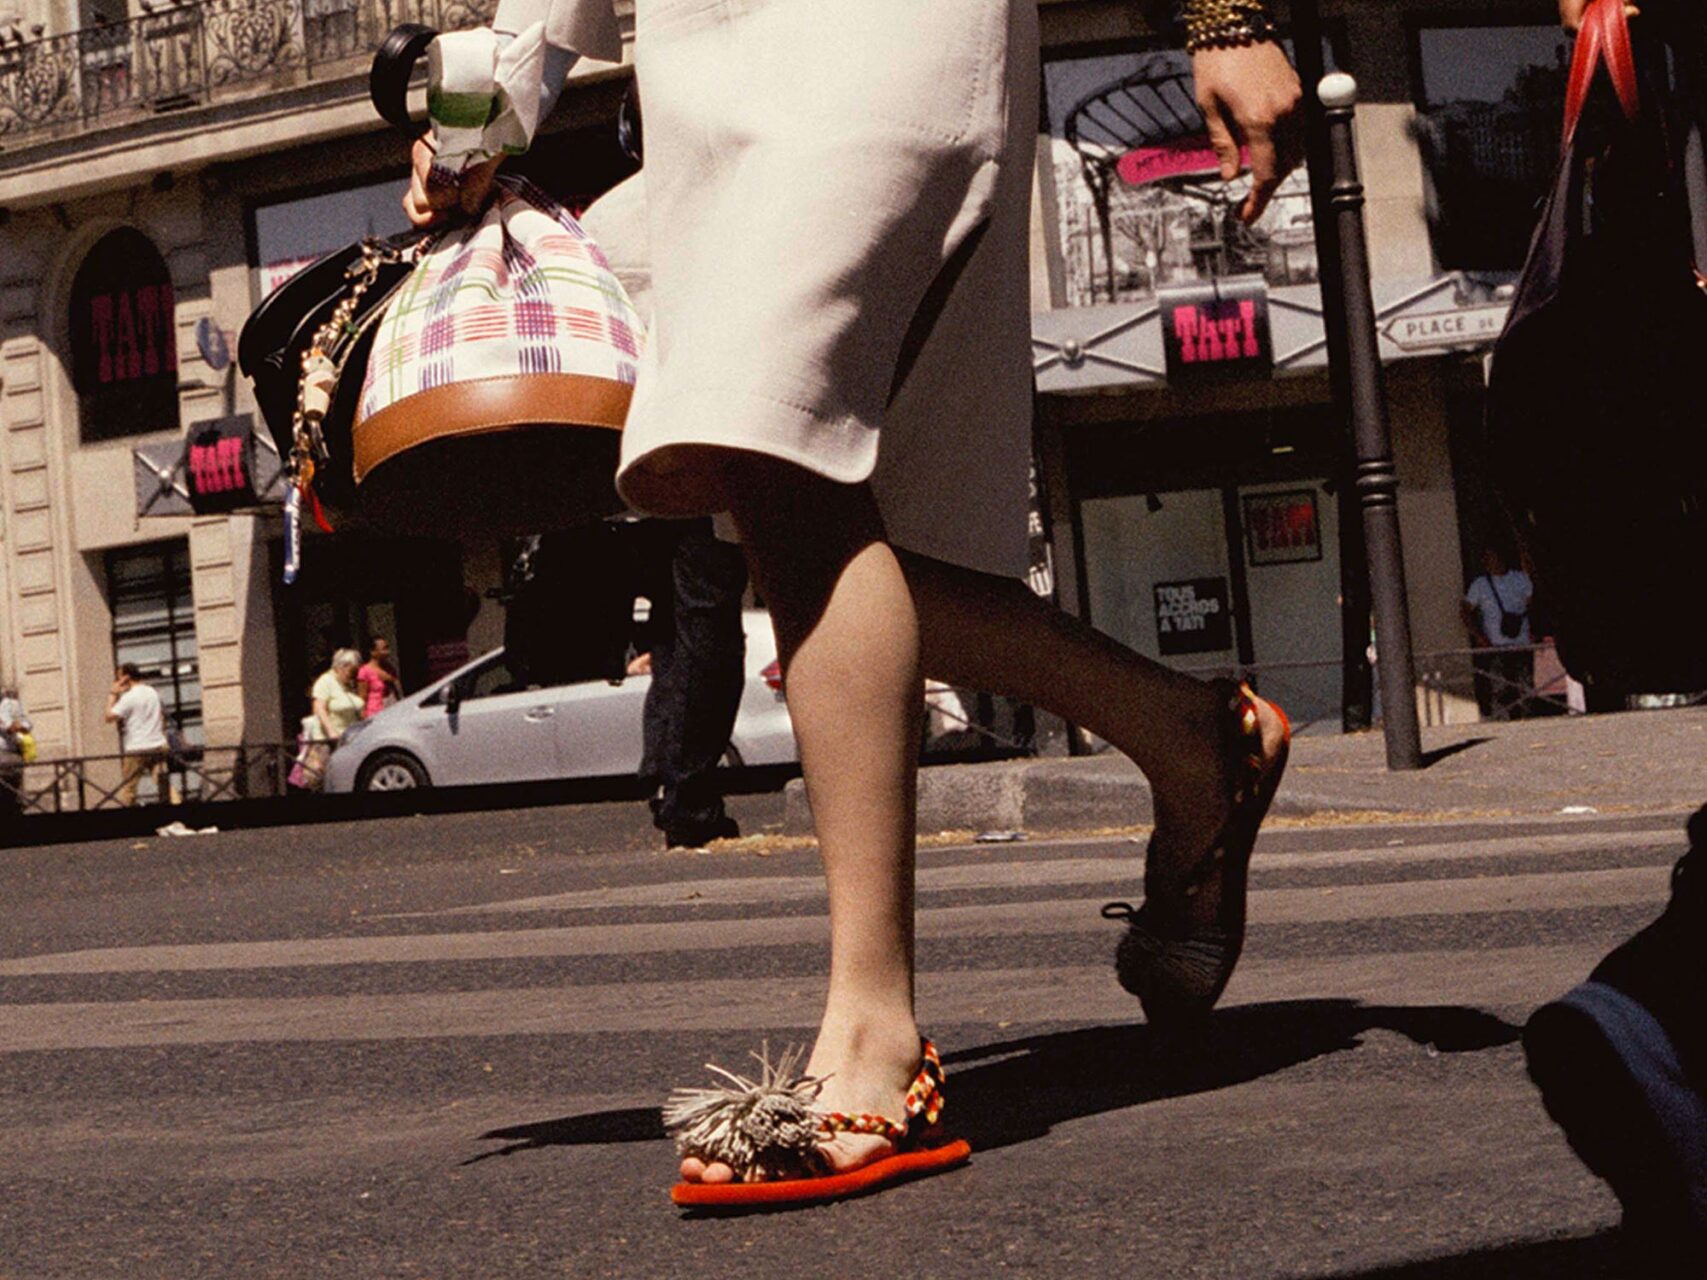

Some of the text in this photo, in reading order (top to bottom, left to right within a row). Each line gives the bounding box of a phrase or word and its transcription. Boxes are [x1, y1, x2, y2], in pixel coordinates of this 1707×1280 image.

[91, 284, 178, 382] TATI
[1173, 300, 1258, 362] TATI
[1406, 317, 1464, 337] PLACE
[190, 436, 245, 494] TATI
[1157, 585, 1196, 603] TOUS
[1158, 598, 1219, 617] ACCROS
[1174, 615, 1205, 631] TATI
